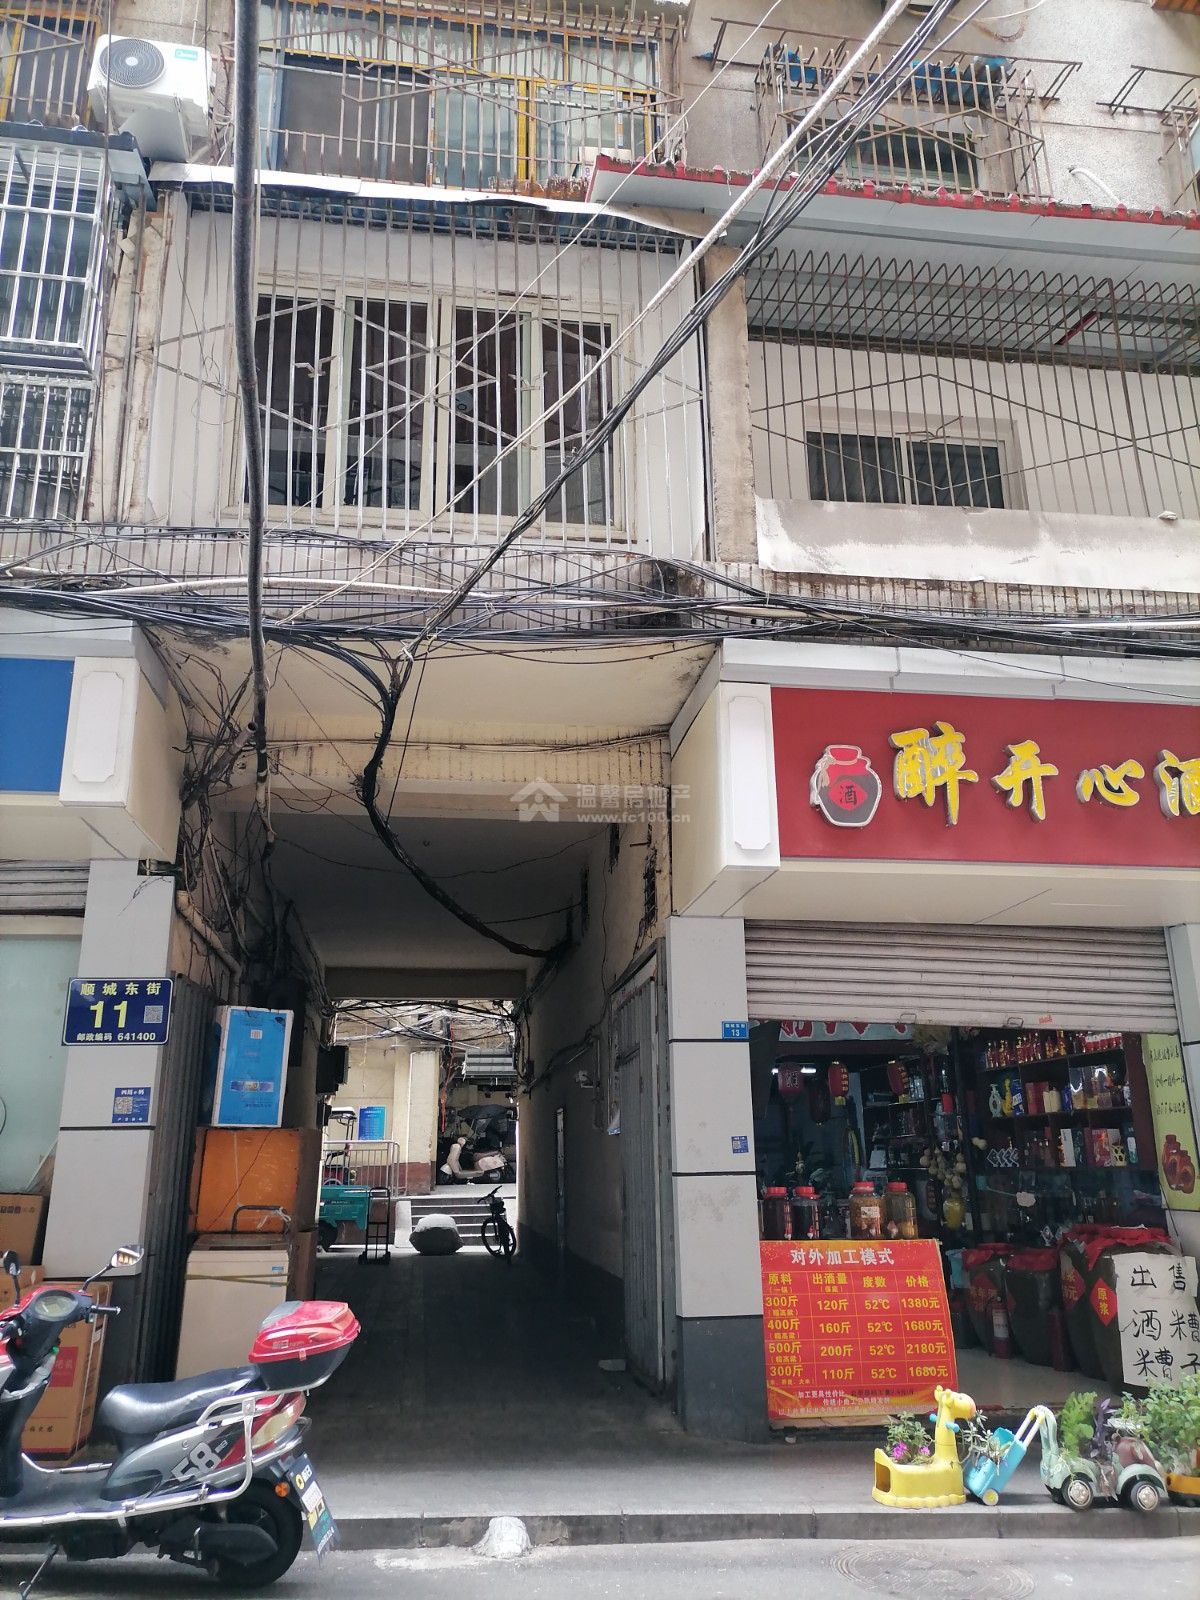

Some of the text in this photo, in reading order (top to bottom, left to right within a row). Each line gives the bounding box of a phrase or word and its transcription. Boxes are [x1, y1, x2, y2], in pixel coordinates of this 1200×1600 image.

[80, 982, 161, 996] 顺城东街
[90, 1001, 128, 1028] 11
[77, 1032, 156, 1041] 邮政编码 641400
[731, 1029, 741, 1037] 13
[790, 1248, 895, 1266] 对外加工模式
[768, 1272, 792, 1286] 原料
[812, 1272, 848, 1285] 出酒量
[863, 1276, 887, 1288] 度数
[905, 1275, 929, 1288] 价格
[1130, 1262, 1186, 1292] 出售
[766, 1296, 798, 1308] 300斤
[817, 1299, 849, 1311] 120斤
[901, 1297, 940, 1309] 1380元
[1098, 1288, 1109, 1316] 原浆
[767, 1319, 800, 1330] 400斤
[819, 1322, 851, 1334] 160斤
[904, 1320, 943, 1332] 1680元
[768, 1341, 802, 1354] 500斤
[820, 1345, 854, 1357] 200斤
[906, 1343, 947, 1354] 2180元
[770, 1365, 804, 1377] 300斤
[822, 1368, 855, 1380] 110斤
[908, 1366, 948, 1377] 1680元
